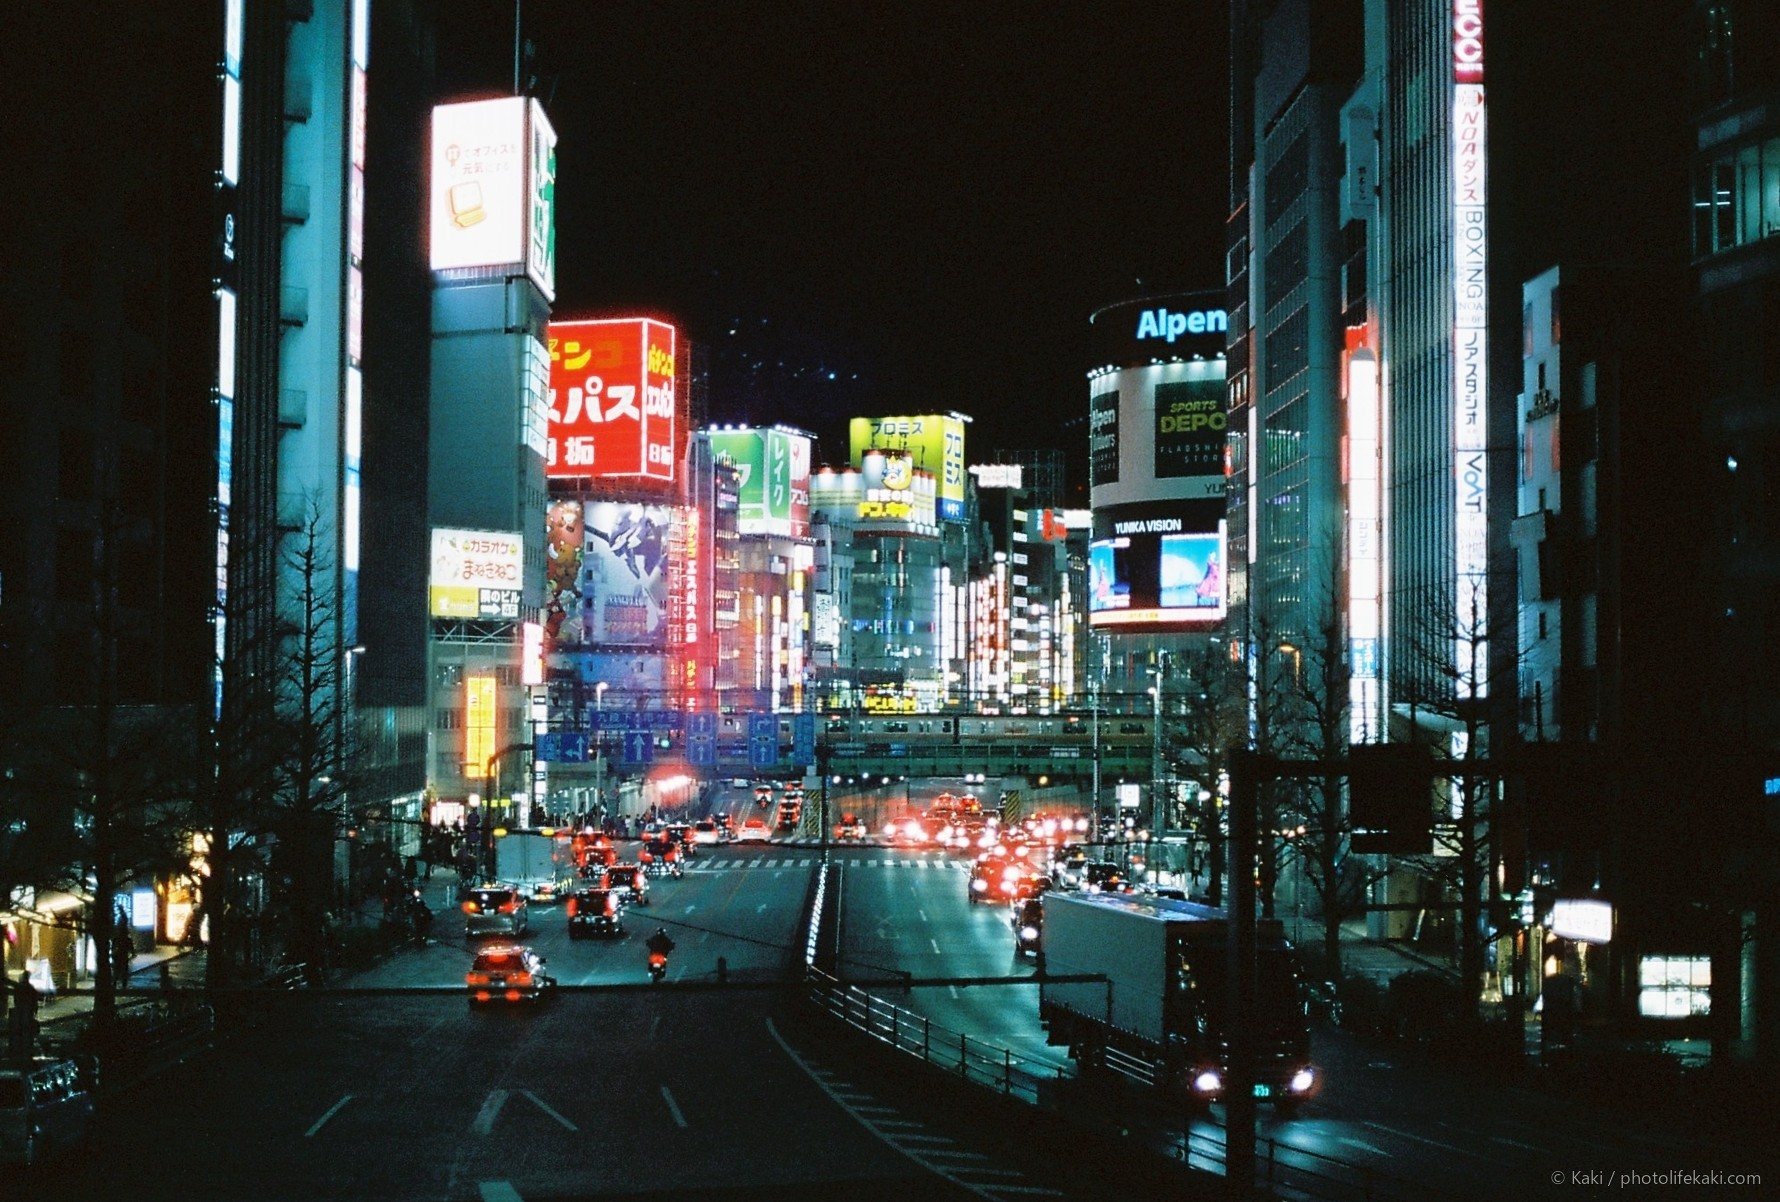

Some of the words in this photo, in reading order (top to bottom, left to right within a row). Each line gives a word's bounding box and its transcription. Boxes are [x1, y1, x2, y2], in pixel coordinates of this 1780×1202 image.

[1461, 111, 1479, 201] NOAダンス
[1466, 210, 1483, 298] BOXING
[1137, 308, 1227, 342] Alpen
[1170, 399, 1218, 413] SPORTS
[773, 437, 784, 507] レイク
[791, 488, 809, 506] アコム
[1115, 521, 1146, 534] YUNIKA
[1147, 519, 1182, 532] VISION
[470, 538, 509, 555] カラオケ
[462, 558, 517, 581] まねきねこ
